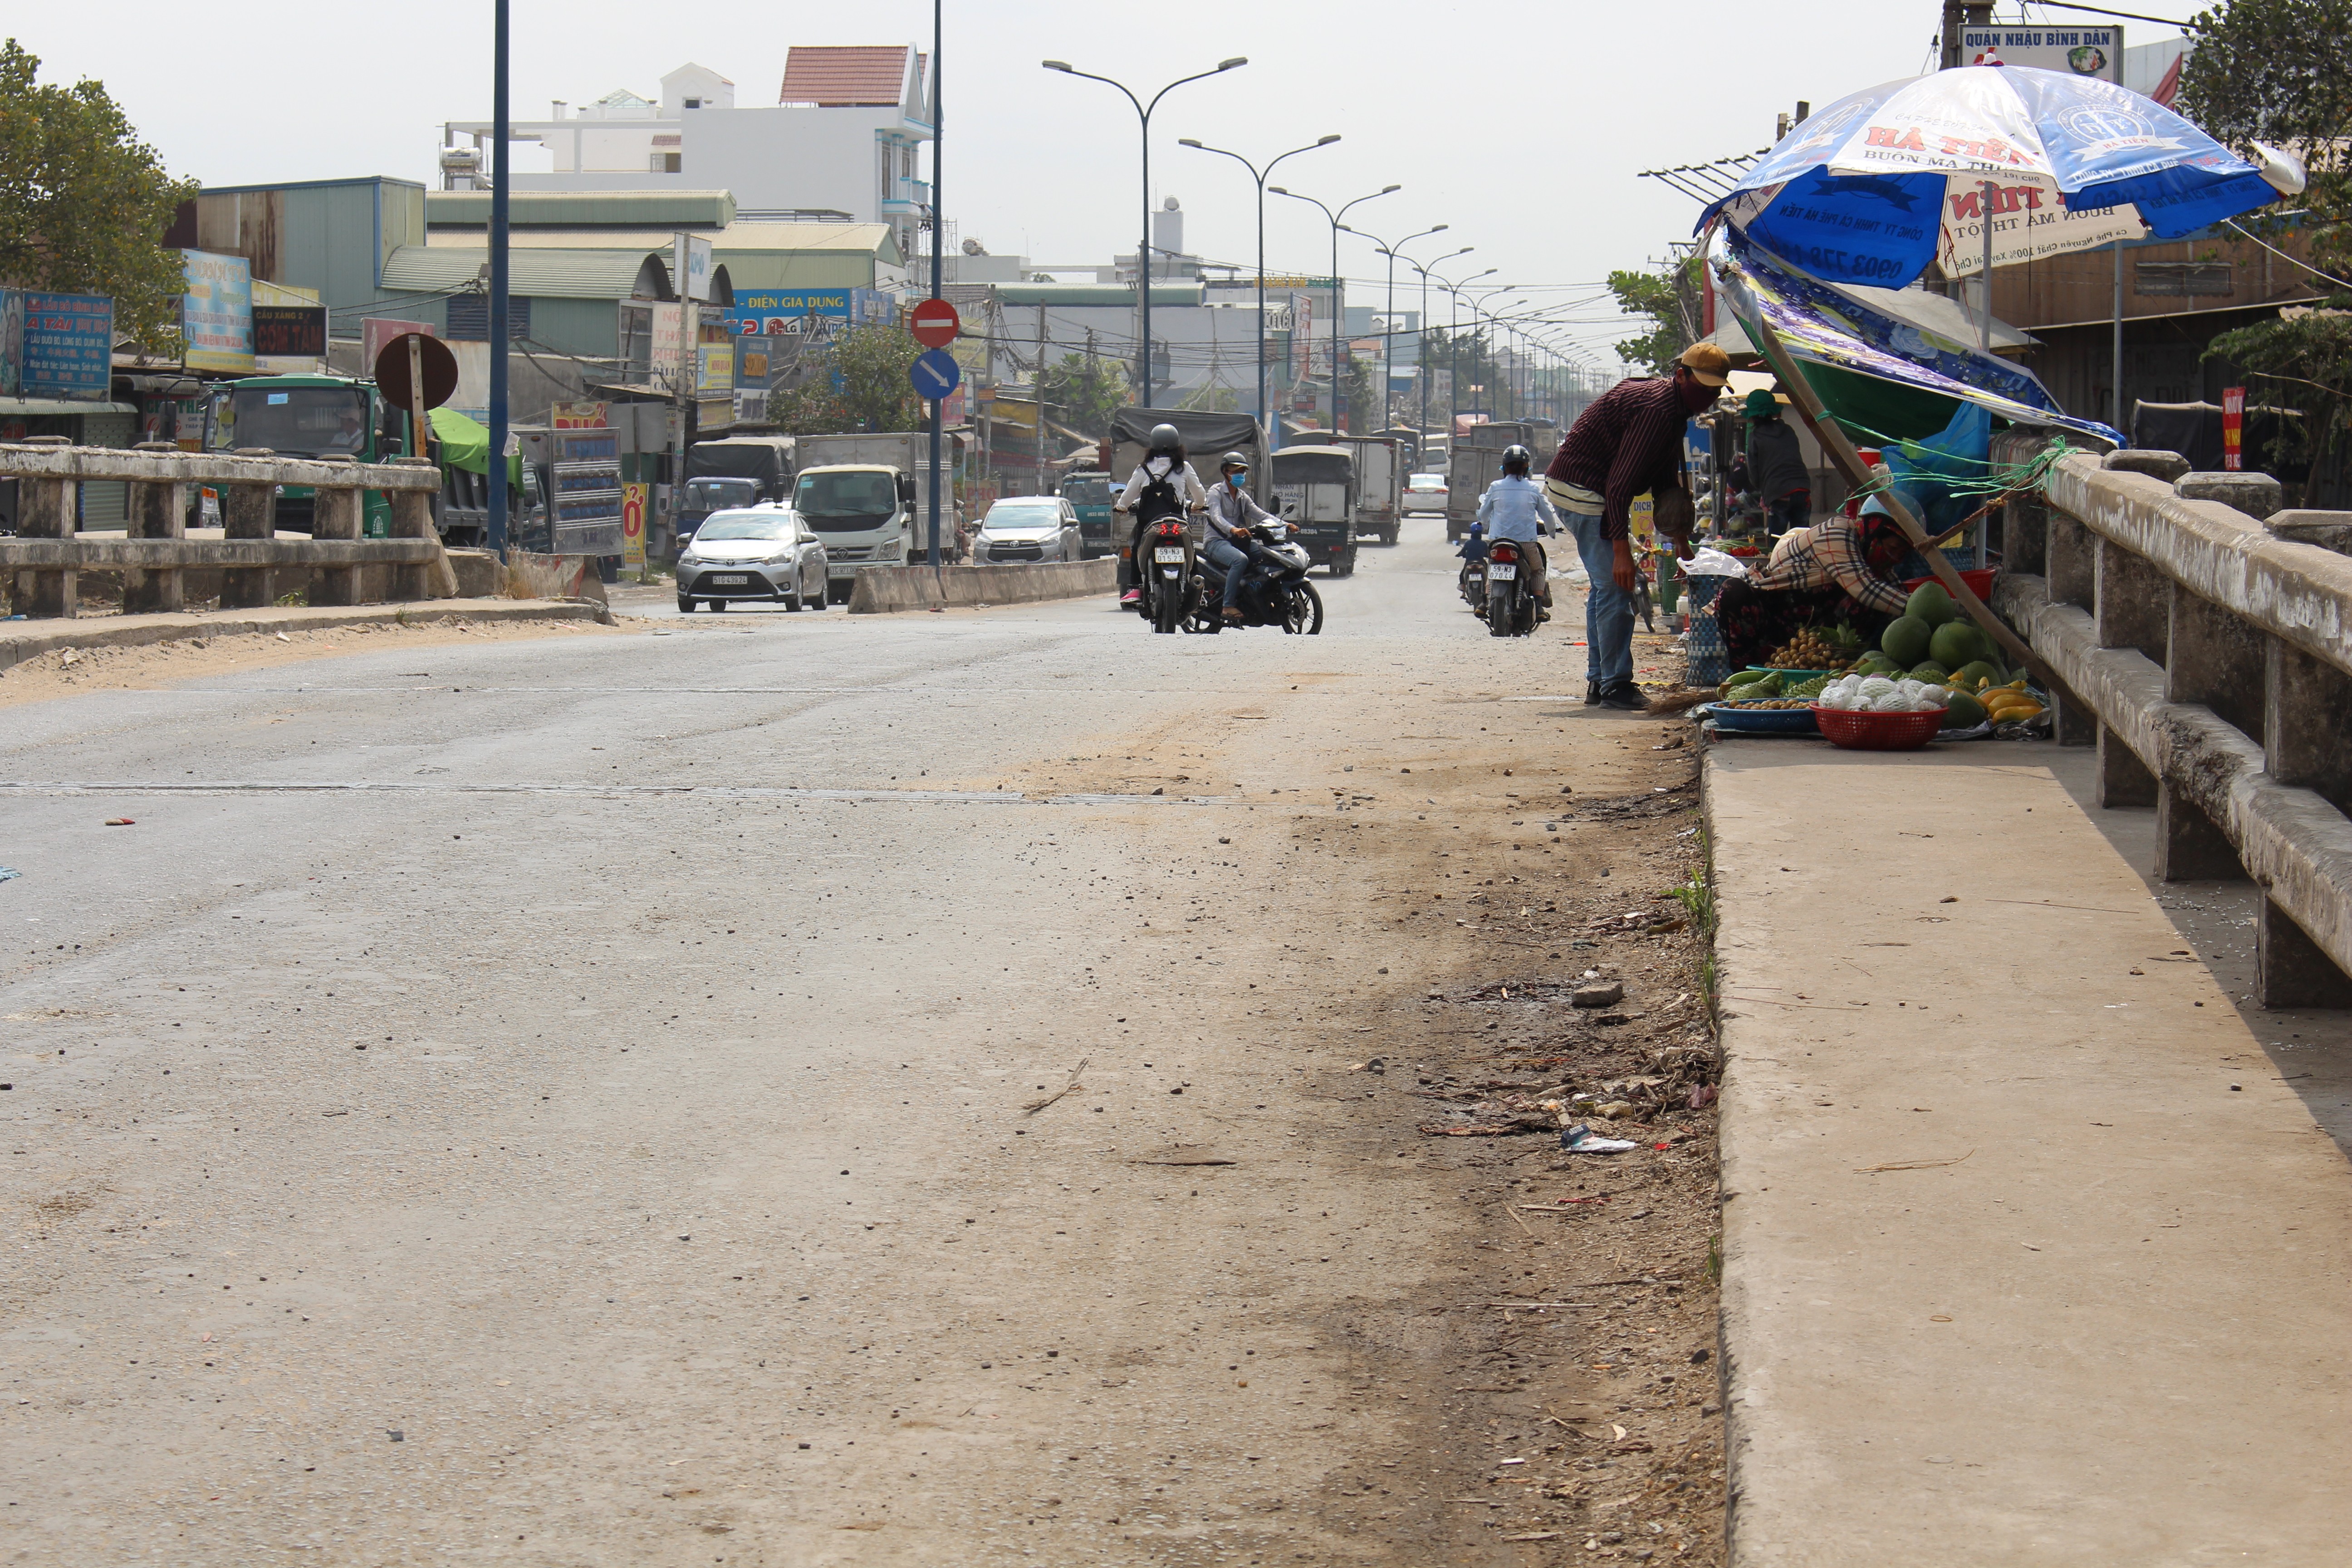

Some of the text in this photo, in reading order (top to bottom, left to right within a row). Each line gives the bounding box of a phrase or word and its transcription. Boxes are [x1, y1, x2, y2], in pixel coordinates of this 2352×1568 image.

[1966, 29, 2110, 49] QUÁN NHẬU BÌNH DÂN
[1865, 127, 1926, 152] HÀ
[1863, 151, 1958, 169] BUÔN MA
[749, 294, 844, 310] ĐIỆN GIA DỤNG
[25, 315, 73, 331] A TÀI
[274, 310, 297, 319] XÁNG
[257, 314, 323, 352] CƠM TẤM
[1634, 501, 1651, 514] DỊCH
